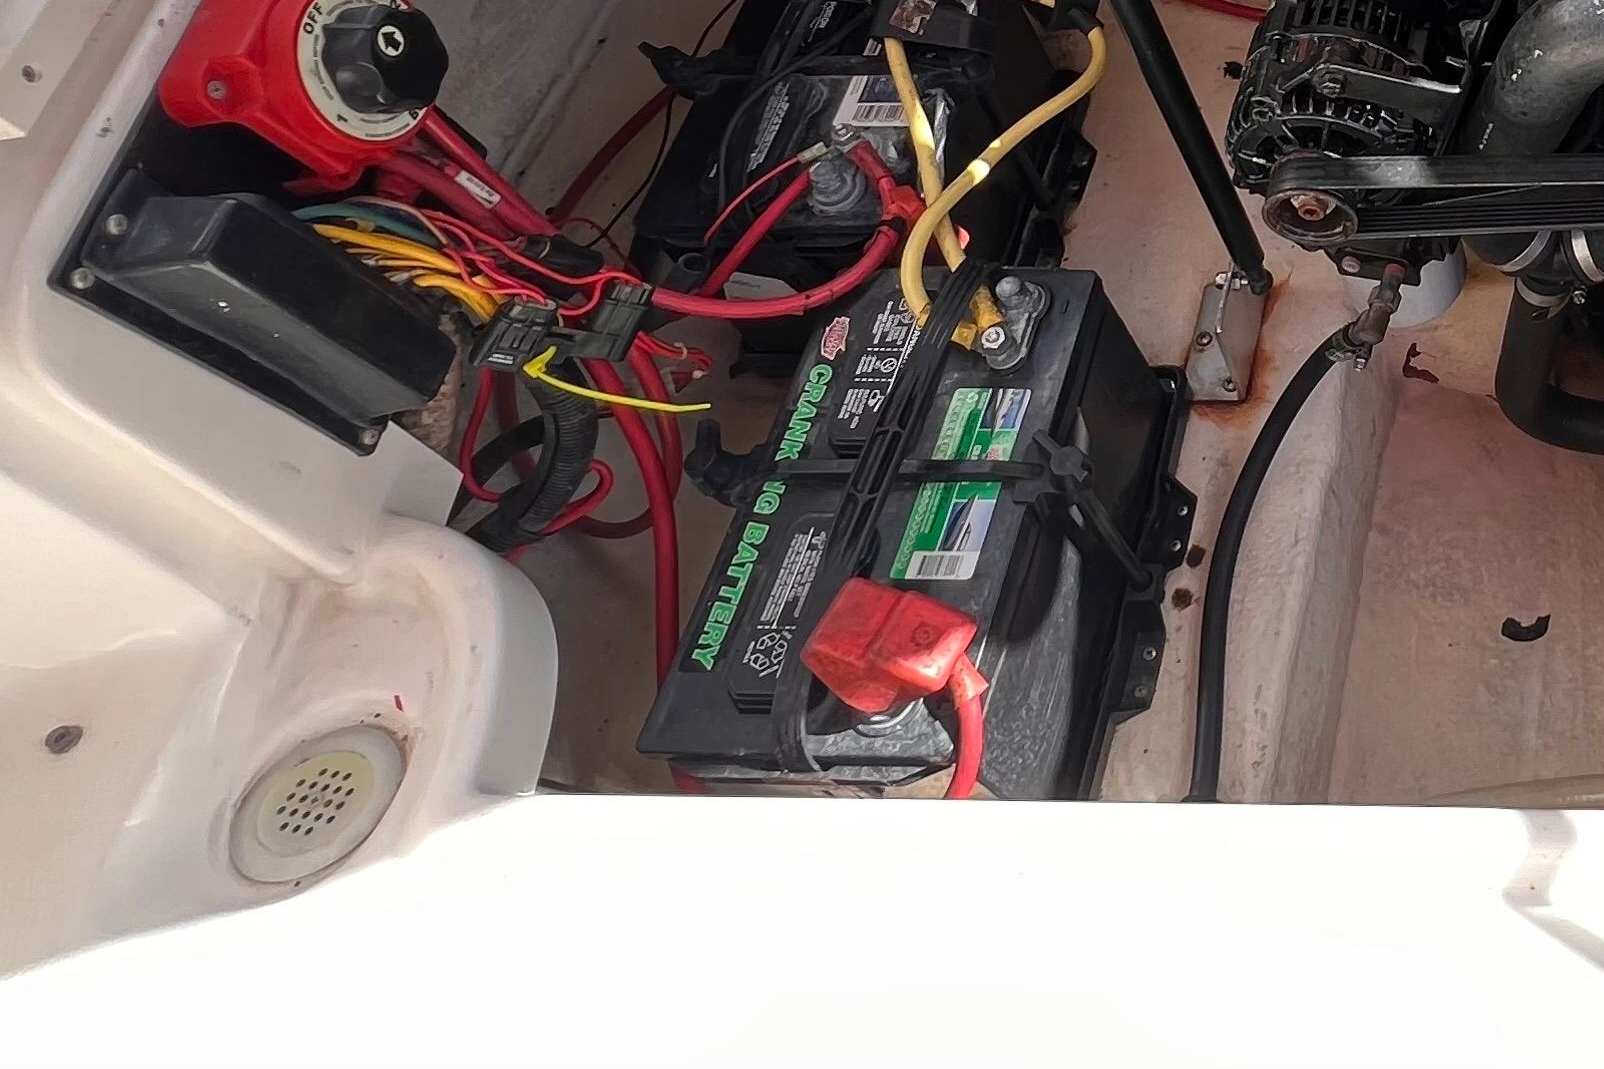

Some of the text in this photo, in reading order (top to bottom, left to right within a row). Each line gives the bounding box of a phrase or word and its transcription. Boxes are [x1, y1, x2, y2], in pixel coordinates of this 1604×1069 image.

[302, 1, 324, 35] OFF
[753, 363, 833, 515] CRANKNG
[692, 521, 770, 671] BATTERY
